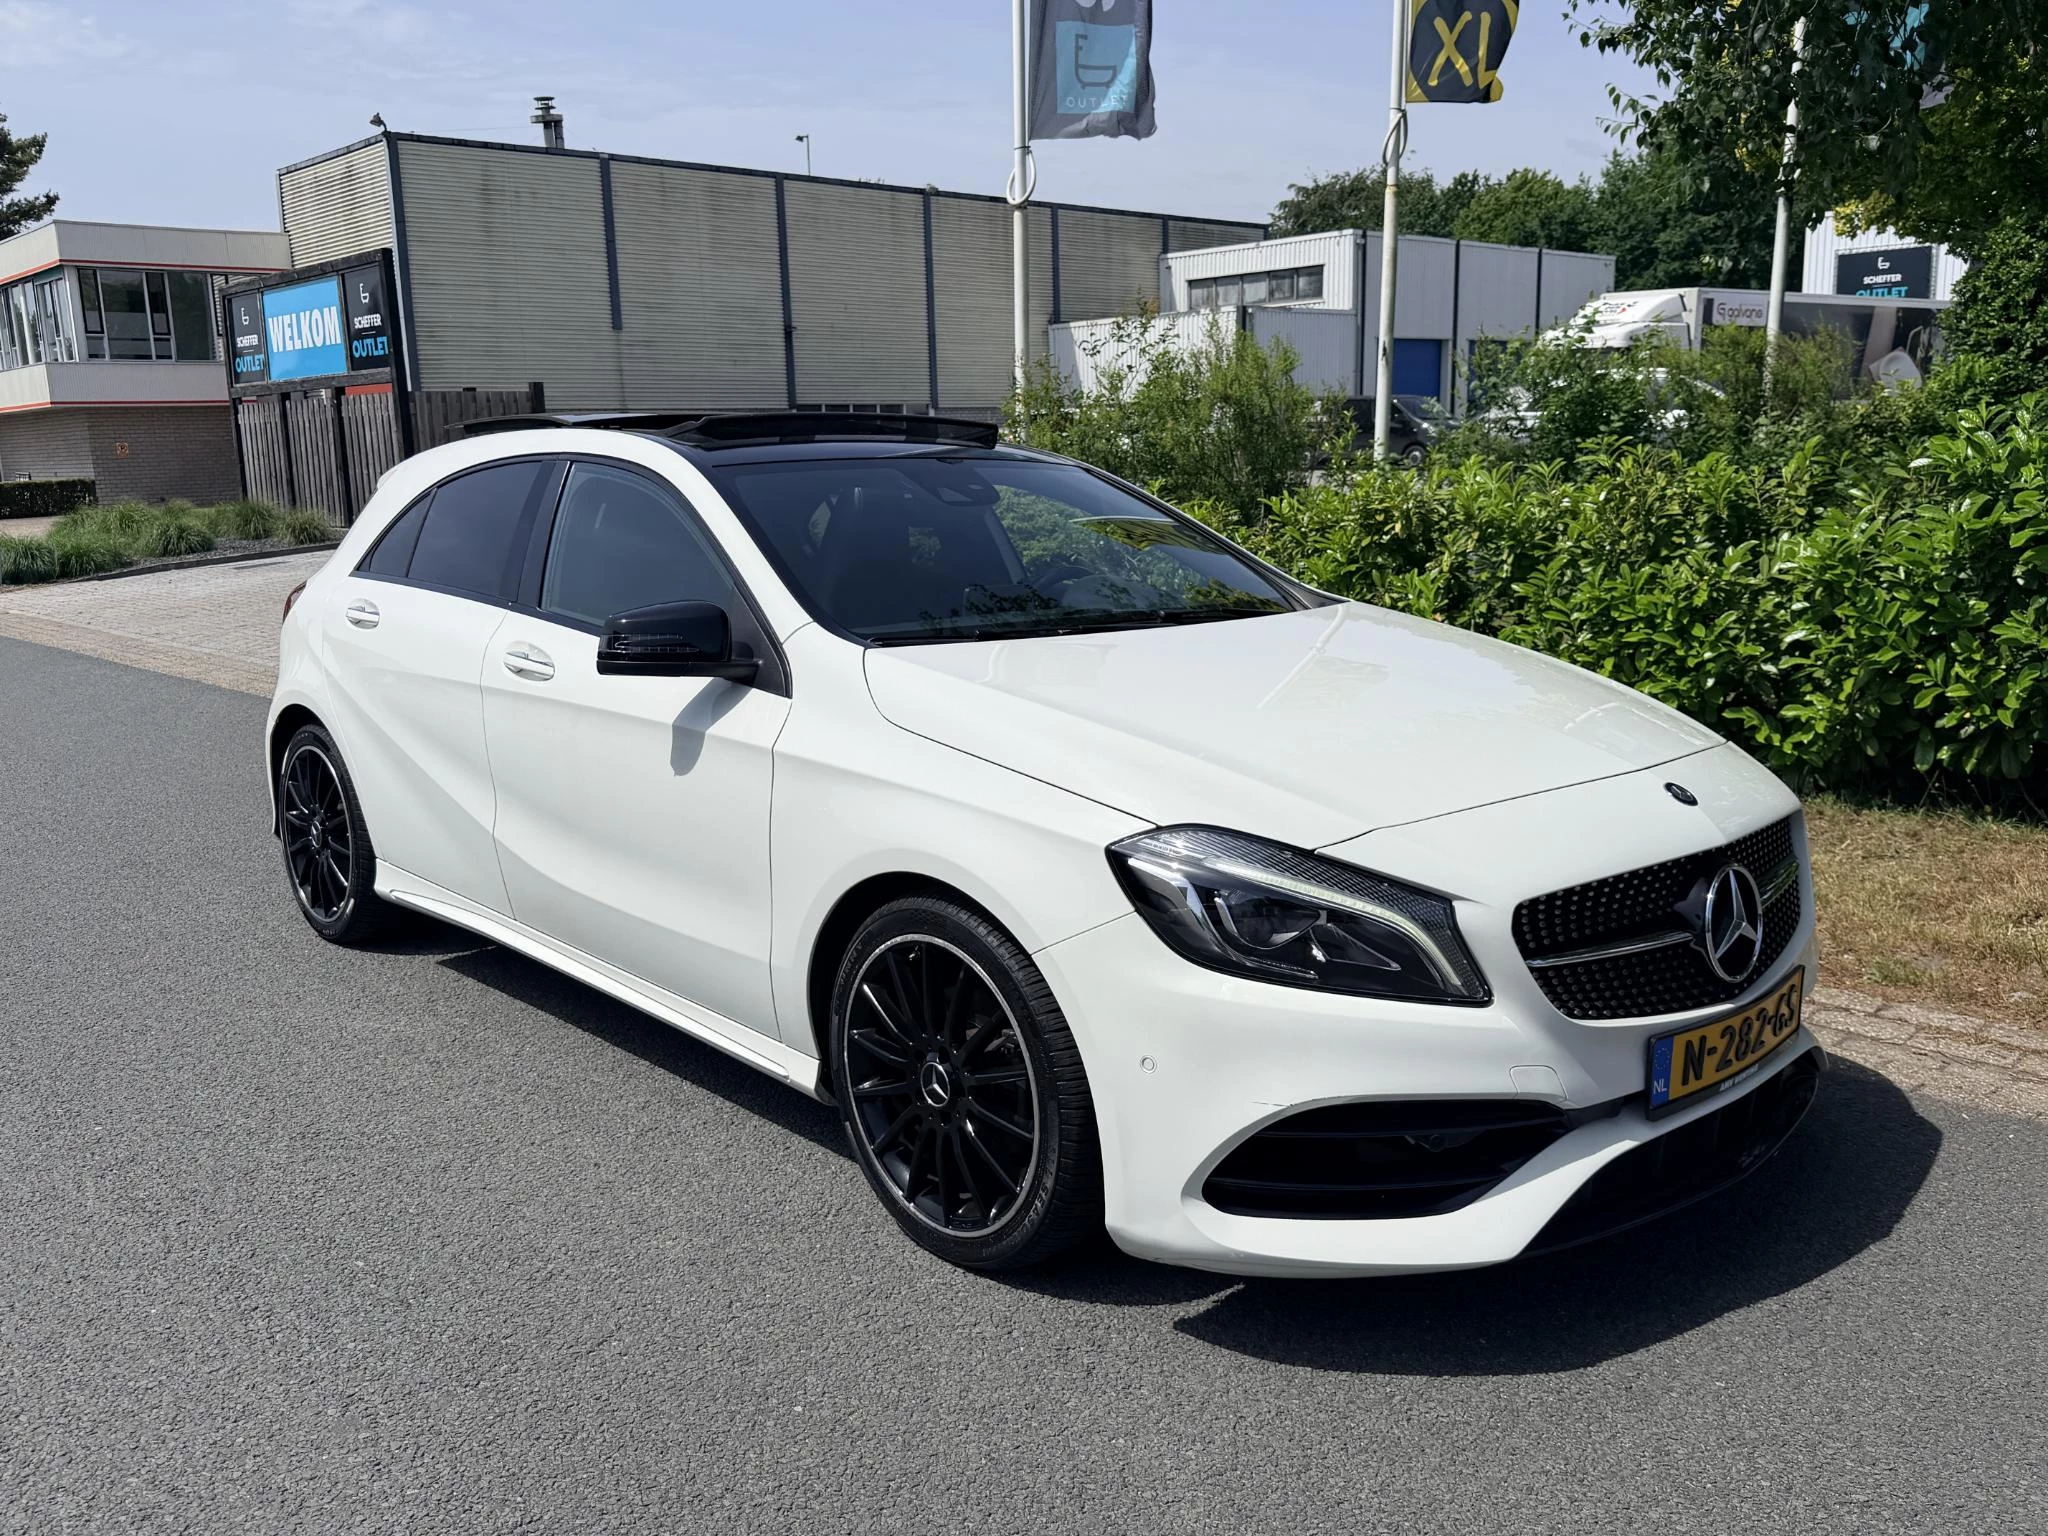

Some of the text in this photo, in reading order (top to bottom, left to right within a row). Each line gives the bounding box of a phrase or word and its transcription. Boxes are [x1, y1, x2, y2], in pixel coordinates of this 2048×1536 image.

[1427, 10, 1498, 89] XL
[1066, 95, 1128, 108] OUTET
[1863, 273, 1902, 285] SCHEFFER
[268, 306, 341, 353] WELKOM
[353, 313, 382, 329] SCHEFFER
[236, 334, 259, 348] SCHEFFER
[352, 336, 389, 358] OUTLET
[235, 354, 265, 373] OUTLET
[1681, 983, 1798, 1086] N-282-GS
[1653, 1078, 1668, 1096] NL
